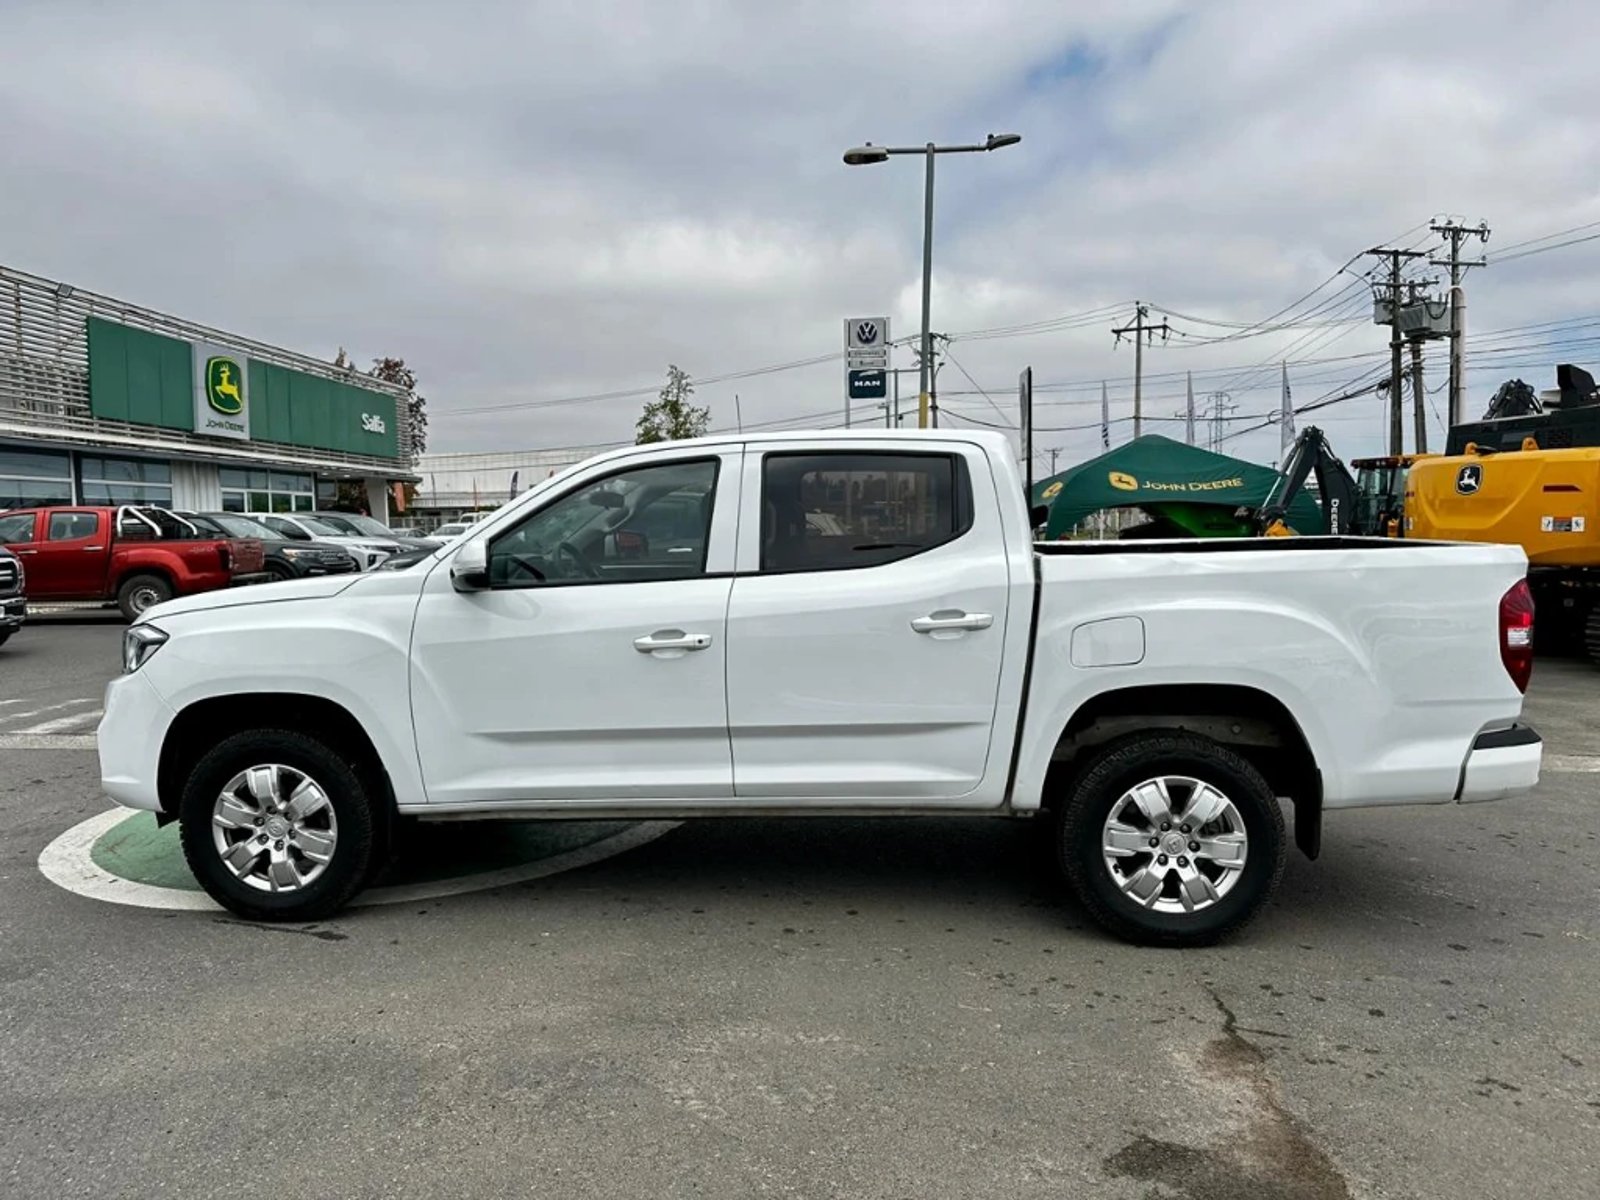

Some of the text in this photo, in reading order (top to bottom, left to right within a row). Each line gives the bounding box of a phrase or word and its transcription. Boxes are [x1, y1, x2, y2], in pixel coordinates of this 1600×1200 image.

[206, 418, 244, 432] JOHN DEERE
[1142, 478, 1244, 491] JOHN DEERE
[1331, 498, 1339, 535] DEERE
